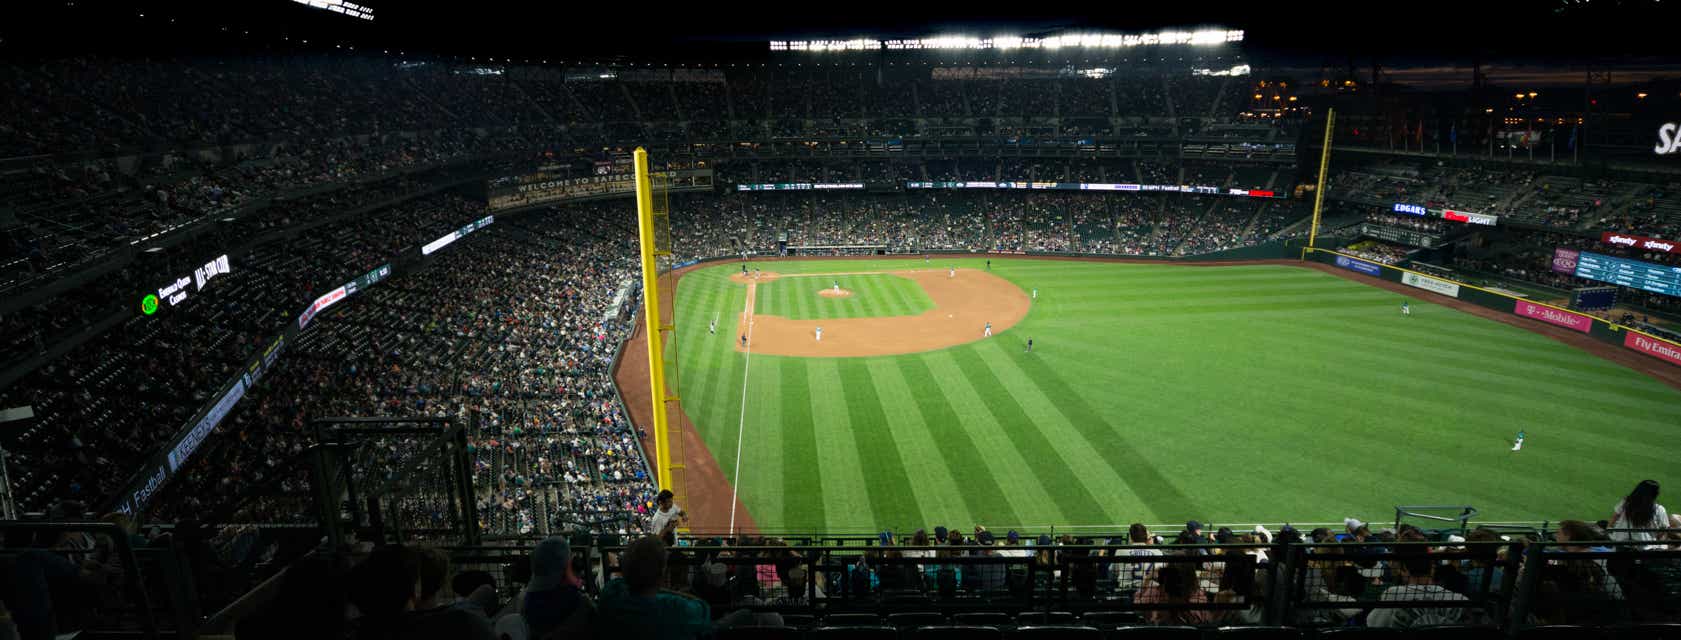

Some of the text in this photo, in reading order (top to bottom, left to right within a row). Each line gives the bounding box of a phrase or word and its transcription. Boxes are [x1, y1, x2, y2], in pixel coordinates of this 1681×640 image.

[519, 180, 570, 192] WELCOME
[575, 177, 589, 185] TO
[1394, 203, 1426, 215] EDGARS
[1468, 216, 1490, 225] LIGHT
[1609, 235, 1674, 251] xfinity xfinity
[1635, 336, 1651, 351] Fly
[133, 465, 166, 509] Fastball
